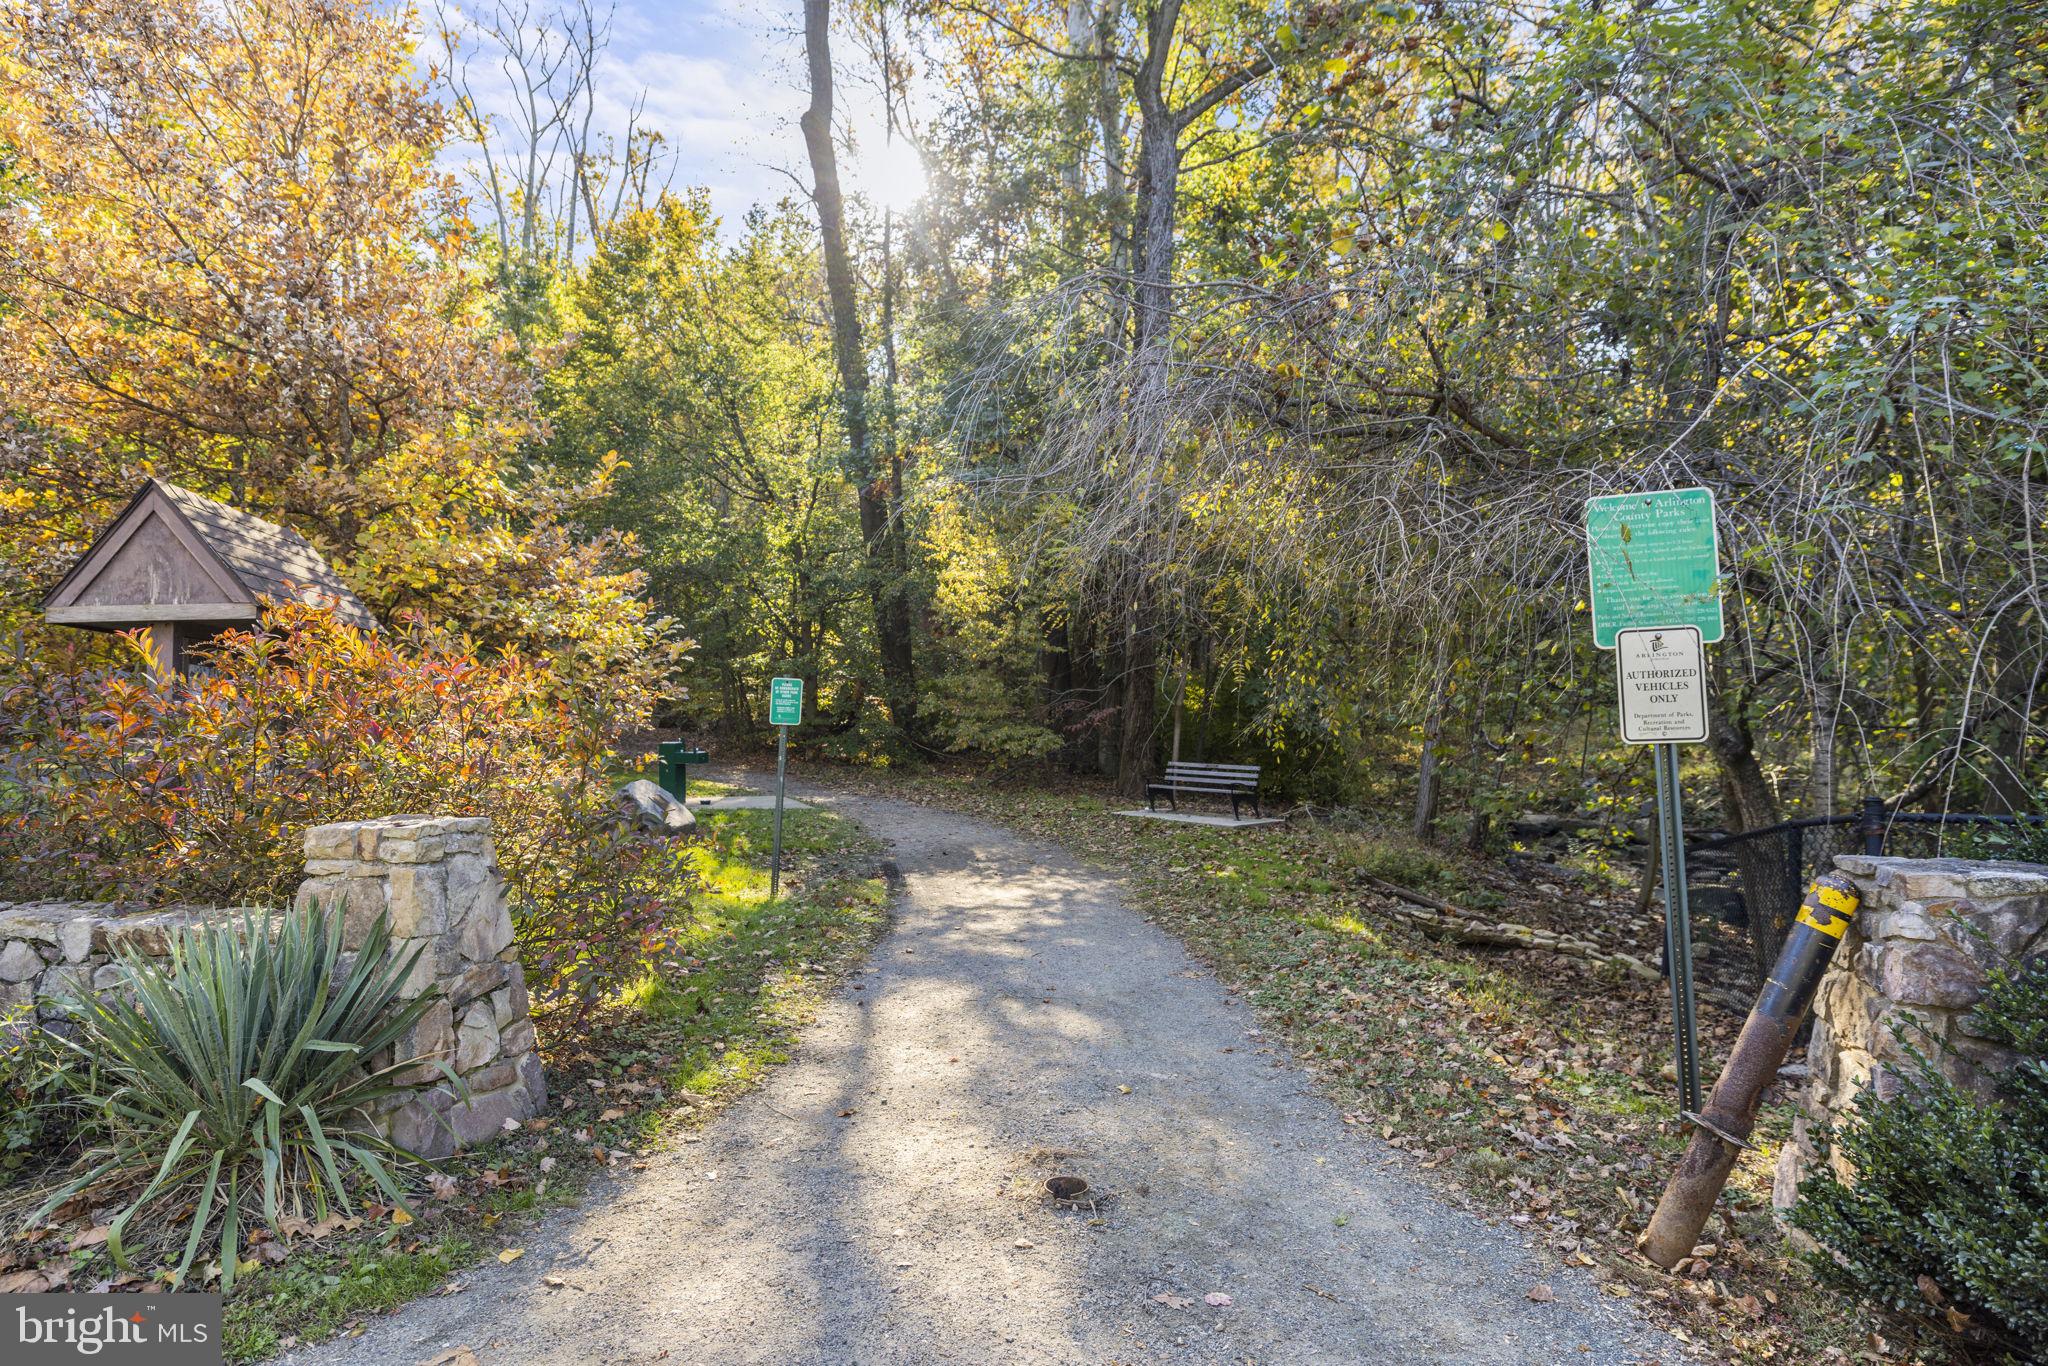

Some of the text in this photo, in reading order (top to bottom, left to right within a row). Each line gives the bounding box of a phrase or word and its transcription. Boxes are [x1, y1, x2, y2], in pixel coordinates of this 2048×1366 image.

[1594, 502, 1637, 513] Welcome
[1654, 496, 1706, 508] Arlington
[1614, 508, 1686, 521] County Parks
[1635, 651, 1685, 659] ARLINGTON
[1626, 668, 1697, 680] AUTHORIZED
[1635, 681, 1689, 692] VEHICLES
[1649, 694, 1678, 703] ONLY
[1634, 712, 1667, 720] Department
